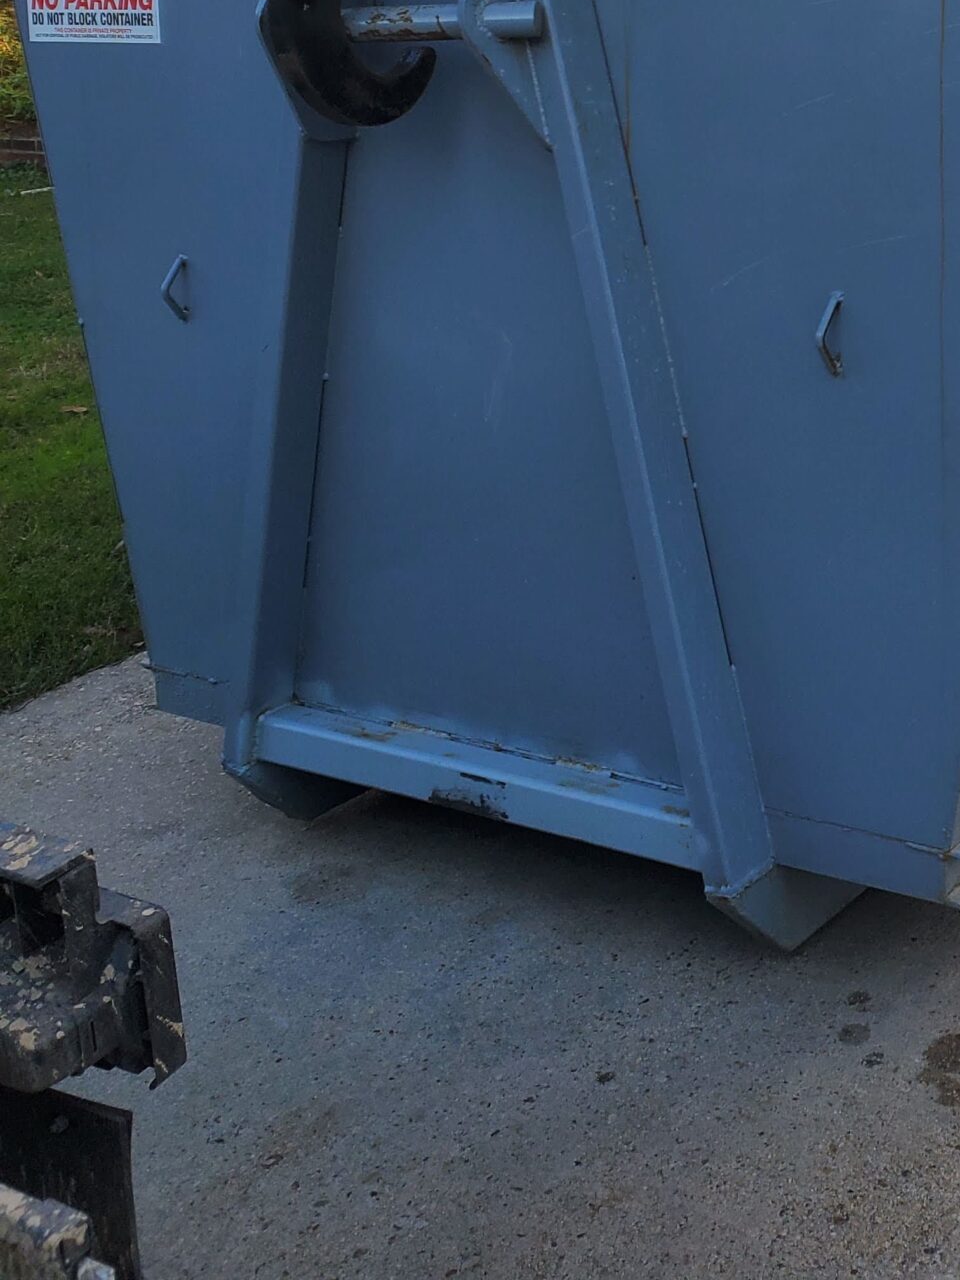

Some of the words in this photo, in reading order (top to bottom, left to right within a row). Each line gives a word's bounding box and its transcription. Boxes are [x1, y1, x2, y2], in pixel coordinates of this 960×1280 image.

[32, 12, 44, 25] DO
[47, 12, 64, 26] NOT
[67, 12, 98, 26] BLOCK
[100, 12, 153, 27] CONTAINER
